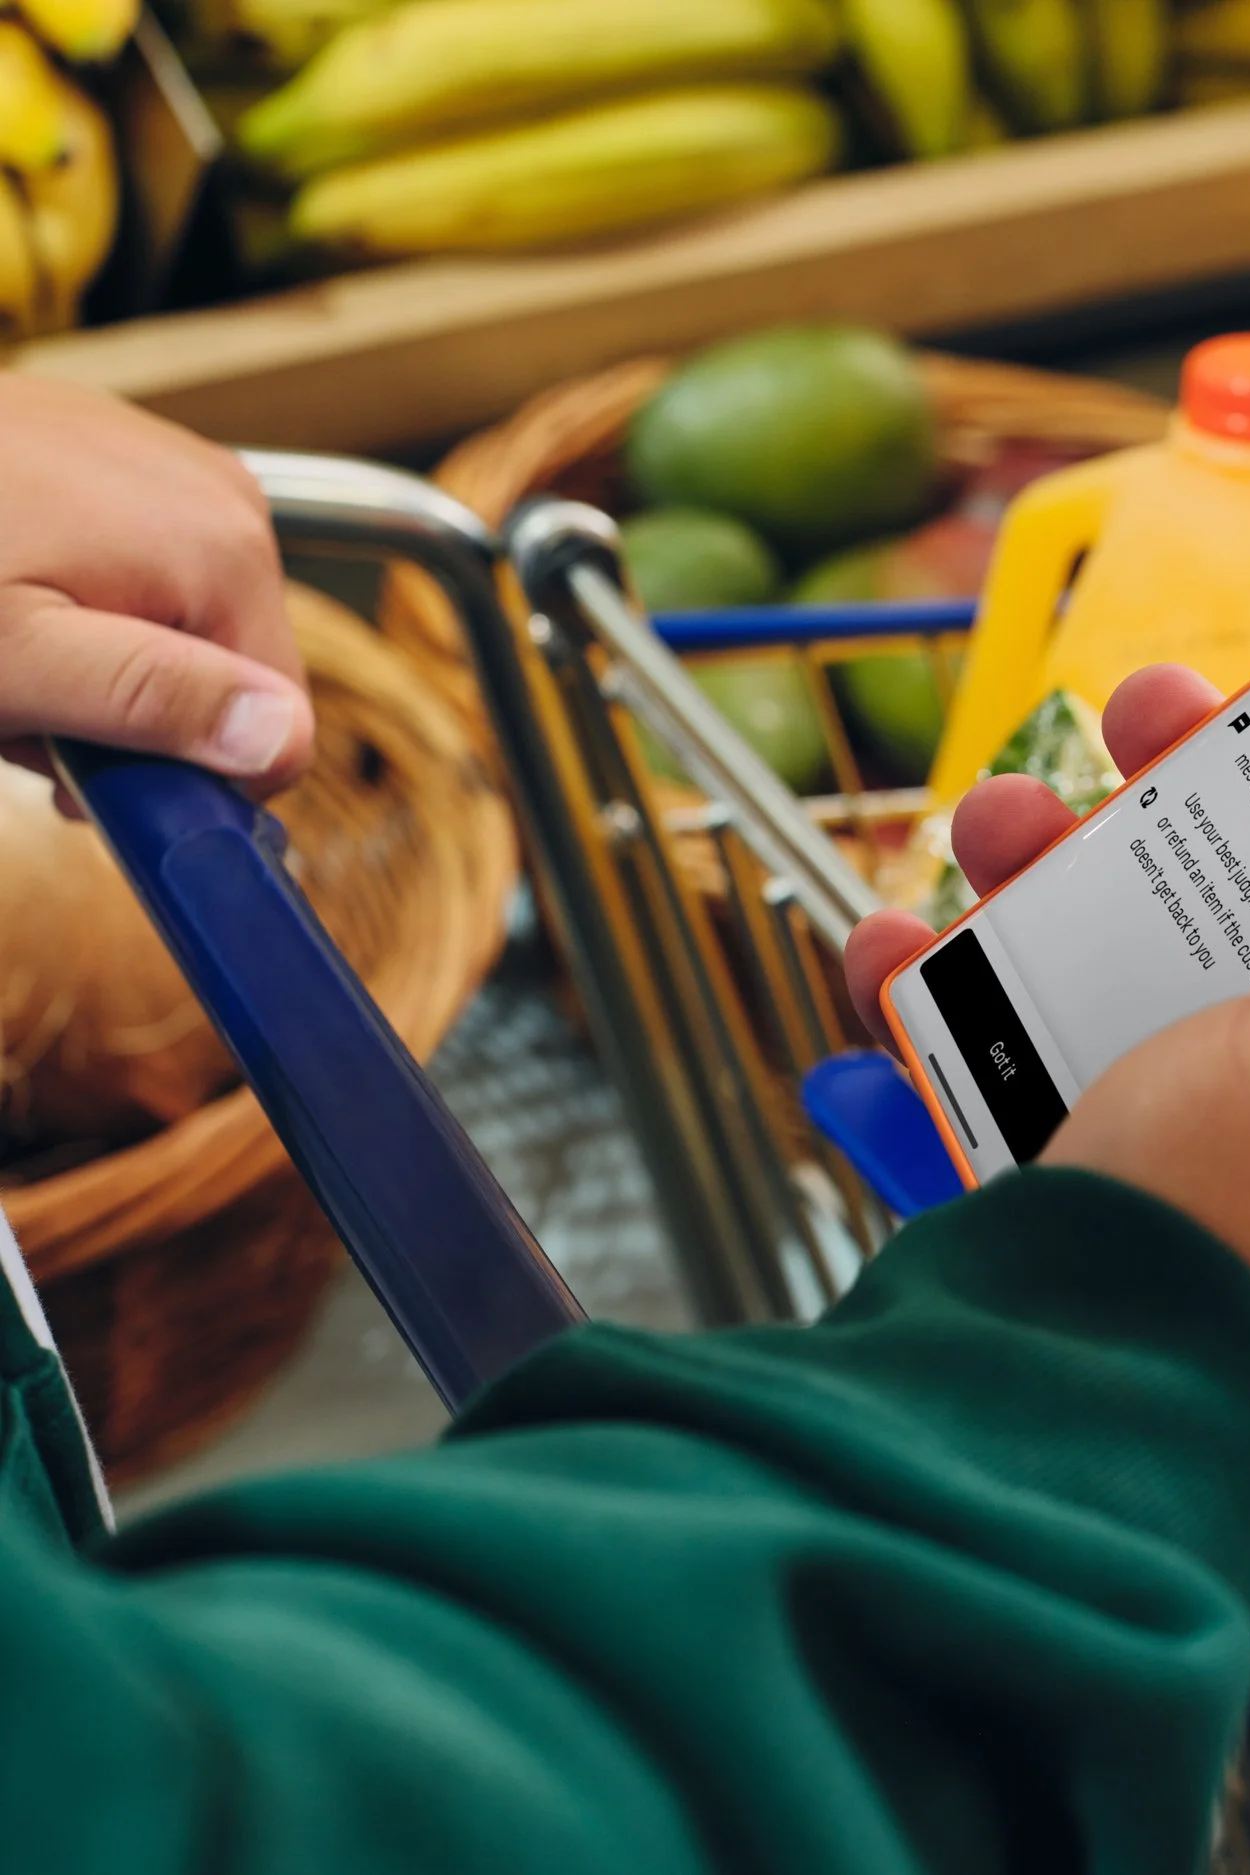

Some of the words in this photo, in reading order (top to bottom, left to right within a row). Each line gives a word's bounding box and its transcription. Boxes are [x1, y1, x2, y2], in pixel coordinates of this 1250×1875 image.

[1184, 792, 1205, 820] Use
[1157, 817, 1172, 832] or
[1194, 816, 1223, 846] your
[1130, 838, 1165, 884] doesn't
[1164, 830, 1200, 871] refund
[1215, 840, 1240, 873] best
[1151, 880, 1177, 904] get
[1189, 869, 1206, 888] an
[1199, 881, 1223, 915] item
[1167, 897, 1195, 934] back
[1217, 909, 1235, 925] if
[1185, 927, 1200, 946] to
[1224, 916, 1243, 947] the
[1189, 942, 1216, 970] you
[990, 1041, 1011, 1070] Got
[1001, 1063, 1017, 1081] it
